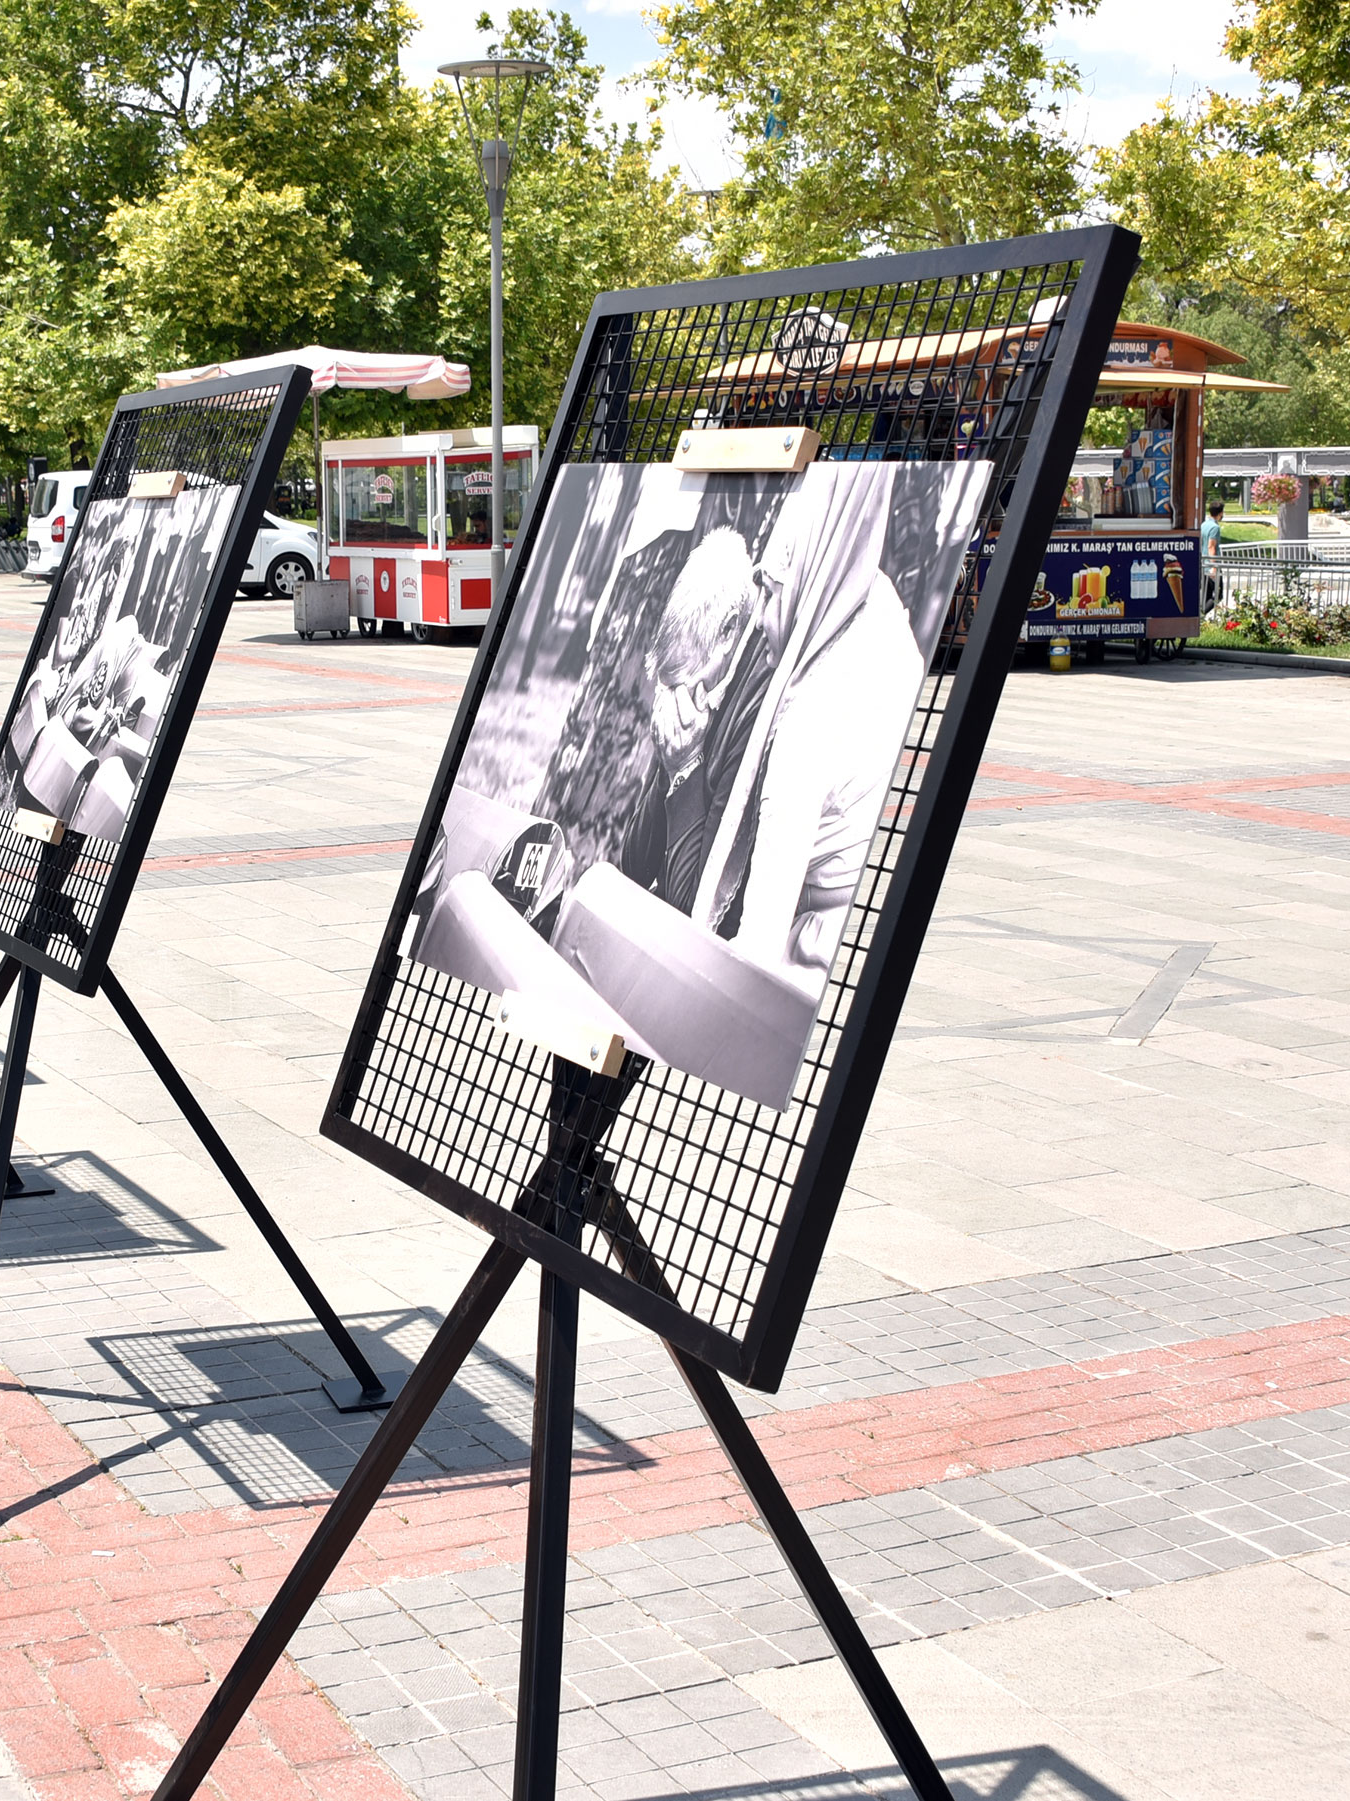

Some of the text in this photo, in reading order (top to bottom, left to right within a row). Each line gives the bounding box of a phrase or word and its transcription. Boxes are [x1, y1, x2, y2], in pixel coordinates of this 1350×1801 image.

[463, 472, 493, 485] TATLIC
[466, 487, 493, 495] SERVE
[1071, 543, 1080, 552] K.
[1116, 542, 1133, 552] TAN
[1134, 540, 1194, 552] GELMEKTEDİR
[1059, 608, 1086, 618] GERÇEK
[1111, 621, 1145, 634] GELMEKTEDİR
